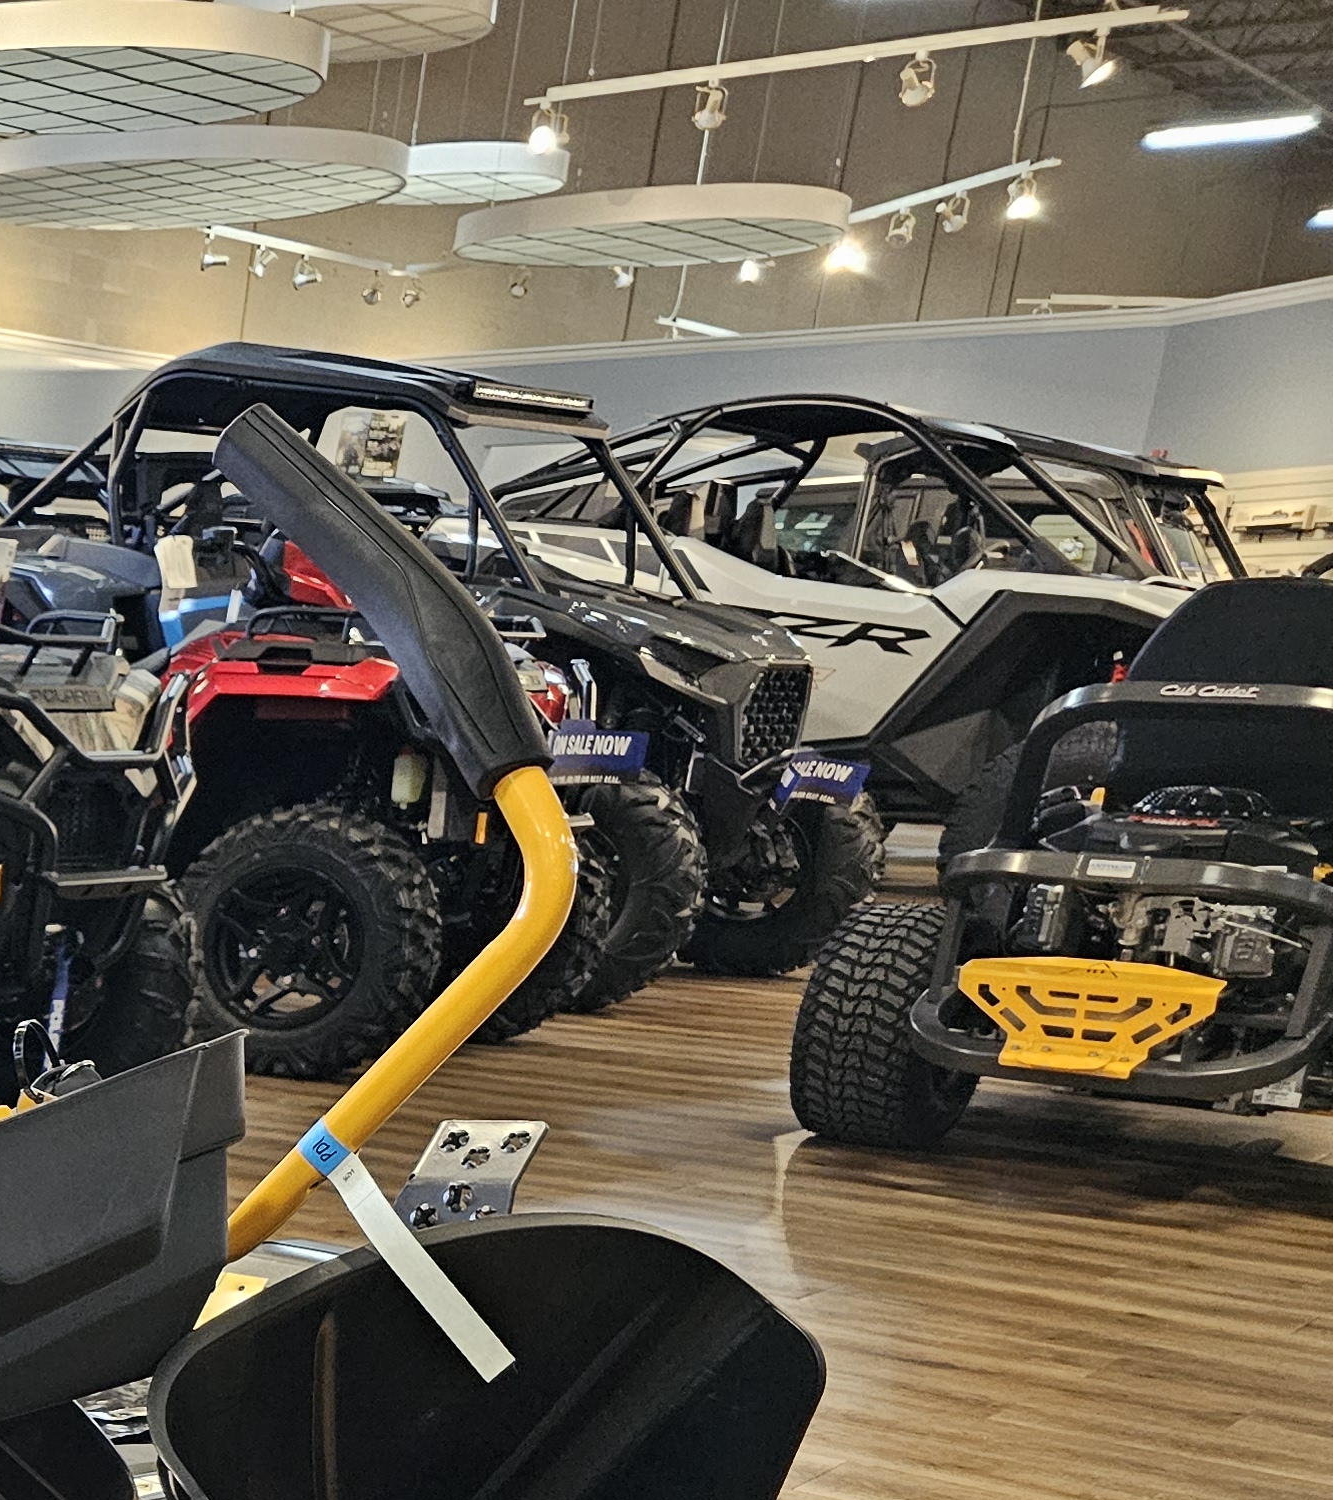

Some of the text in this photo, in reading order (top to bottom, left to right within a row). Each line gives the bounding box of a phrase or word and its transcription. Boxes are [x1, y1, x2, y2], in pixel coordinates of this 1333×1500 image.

[1160, 684, 1260, 699] Cub Cadet
[553, 734, 632, 756] ON SALE NOW
[813, 761, 854, 783] NOW
[312, 1135, 338, 1162] PDI
